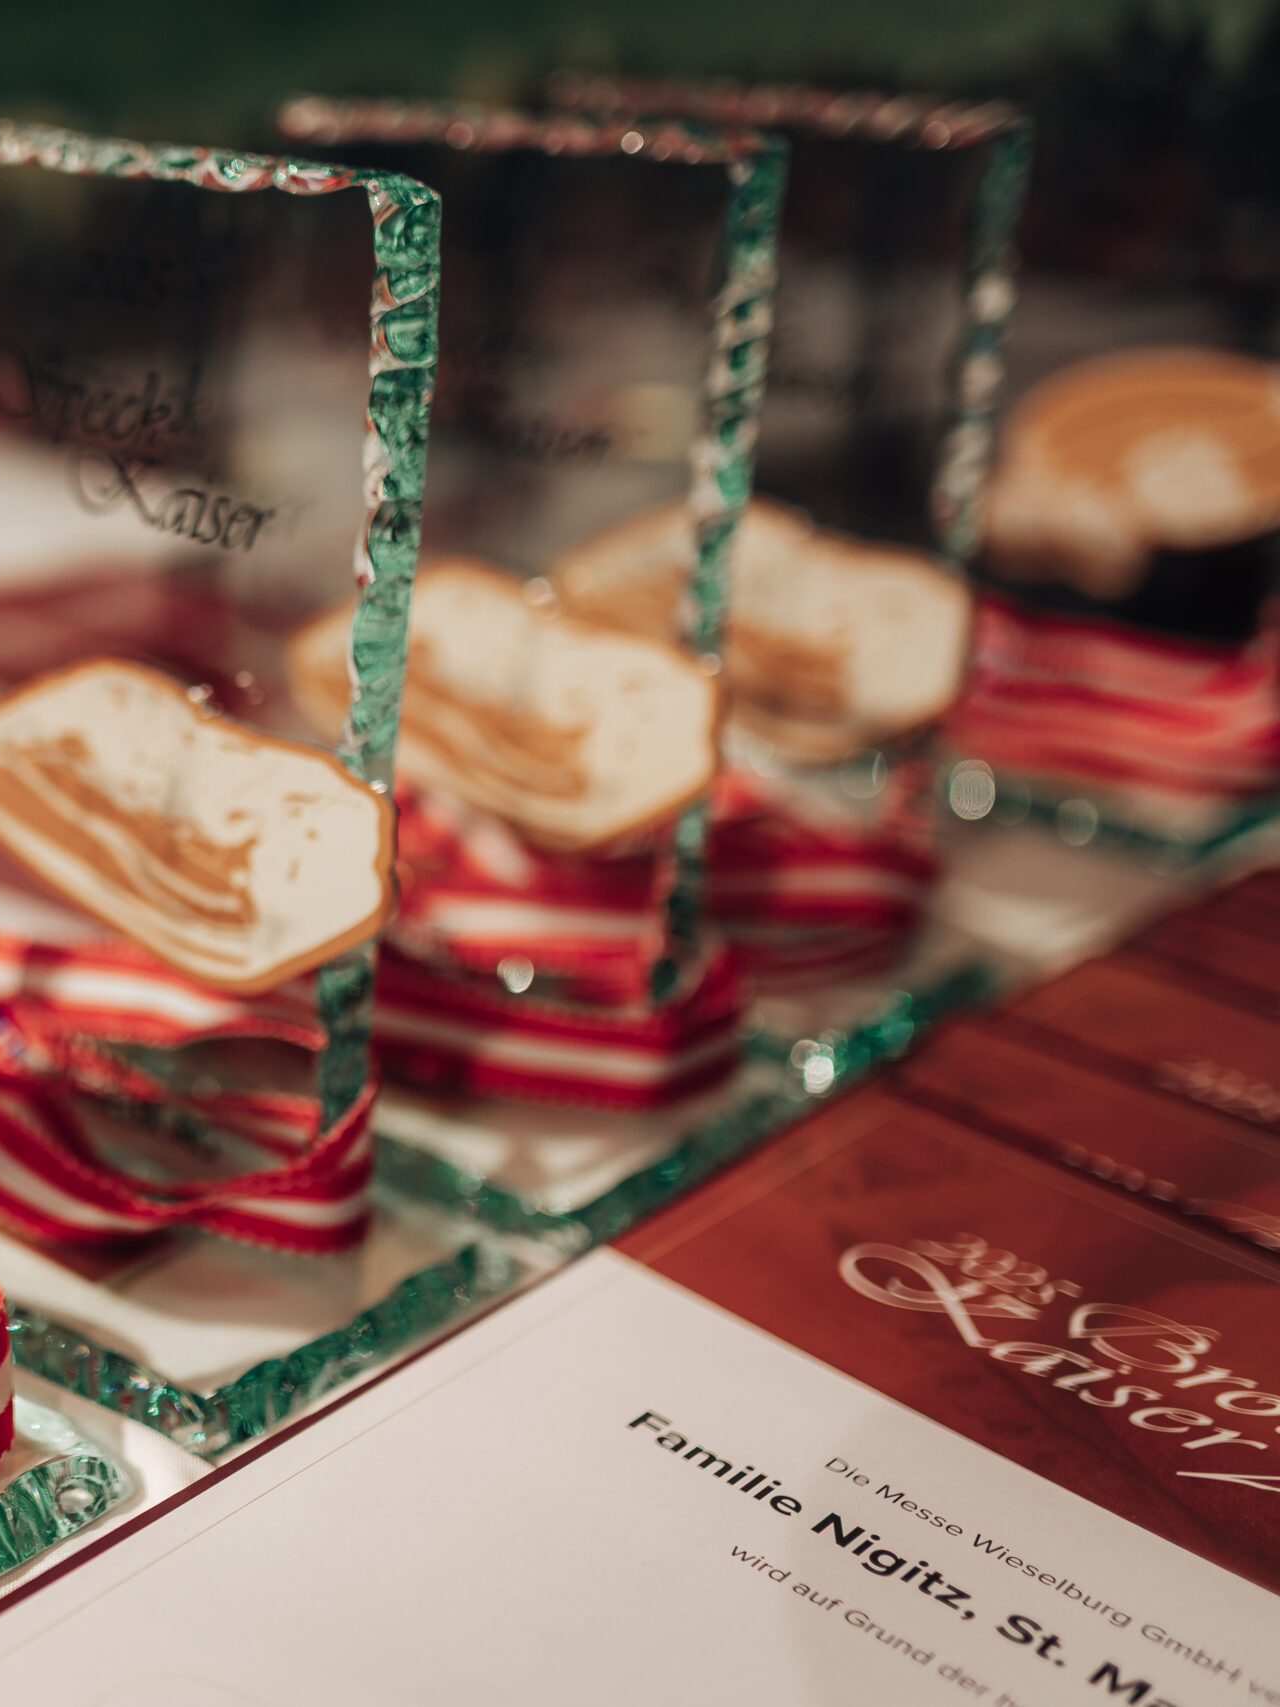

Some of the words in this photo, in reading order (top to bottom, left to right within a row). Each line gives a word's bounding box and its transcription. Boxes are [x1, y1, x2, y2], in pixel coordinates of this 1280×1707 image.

[838, 1242, 1268, 1450] Kaiser
[1068, 1302, 1280, 1434] Bro
[626, 1410, 803, 1517] Familie
[810, 1512, 976, 1622] Nigitz,
[995, 1613, 1065, 1667] St.
[730, 1545, 792, 1583] wird
[791, 1582, 844, 1612] auf
[843, 1608, 937, 1667] Grund
[937, 1662, 991, 1698] der
[824, 1456, 870, 1487] Die
[875, 1484, 964, 1537] Messe
[973, 1533, 1133, 1628] Wieselburg
[1140, 1623, 1243, 1684] GmbH
